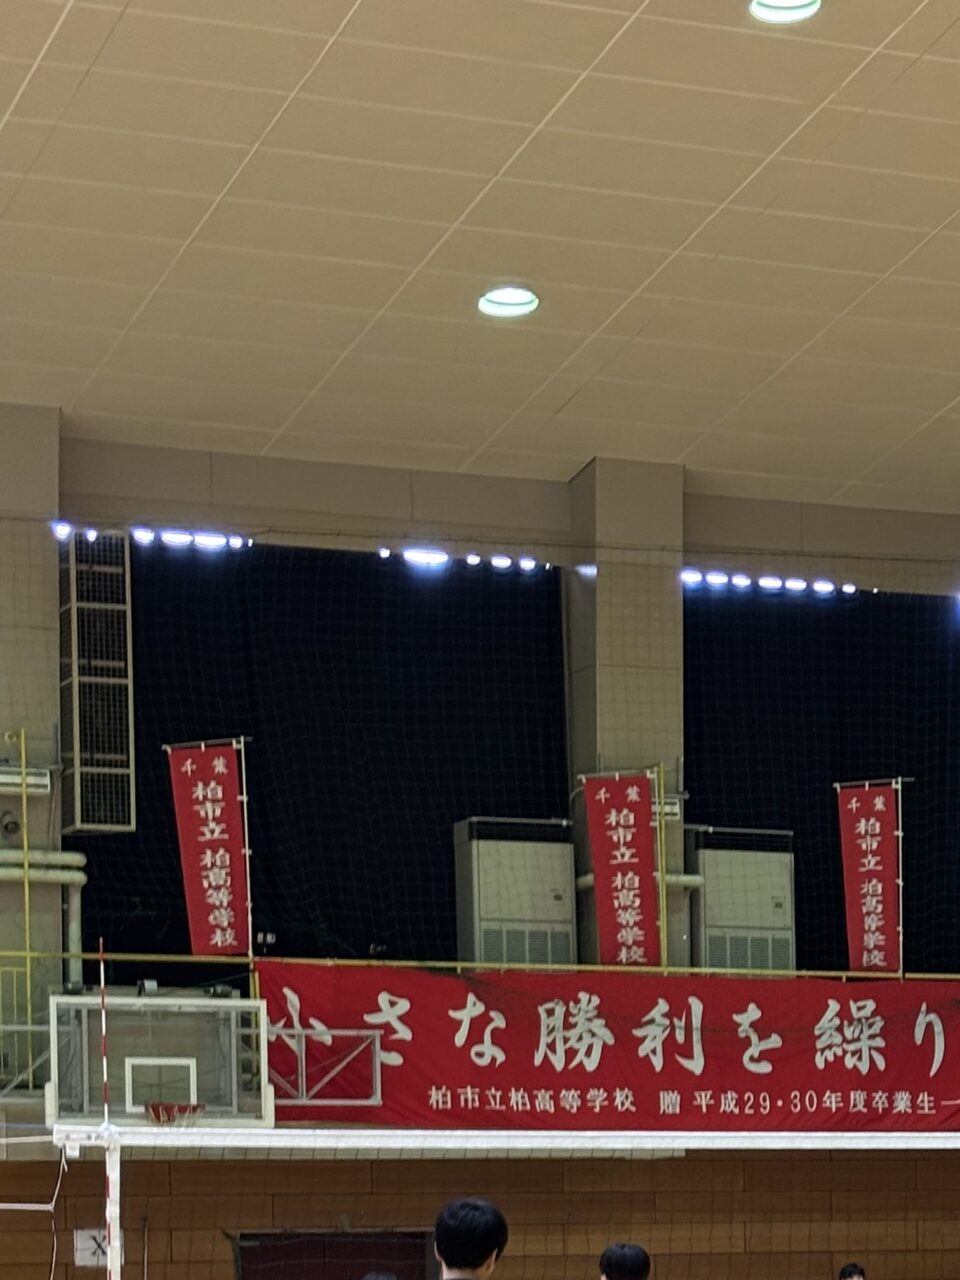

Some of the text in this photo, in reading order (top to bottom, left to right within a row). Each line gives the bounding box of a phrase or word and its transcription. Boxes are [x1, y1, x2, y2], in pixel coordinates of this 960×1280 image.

[181, 755, 228, 777] 千葉
[595, 785, 641, 804] 千葉
[847, 795, 887, 813] 千葉
[428, 1085, 637, 1114] 柏市立柏高等学校
[659, 1090, 681, 1115] 贈
